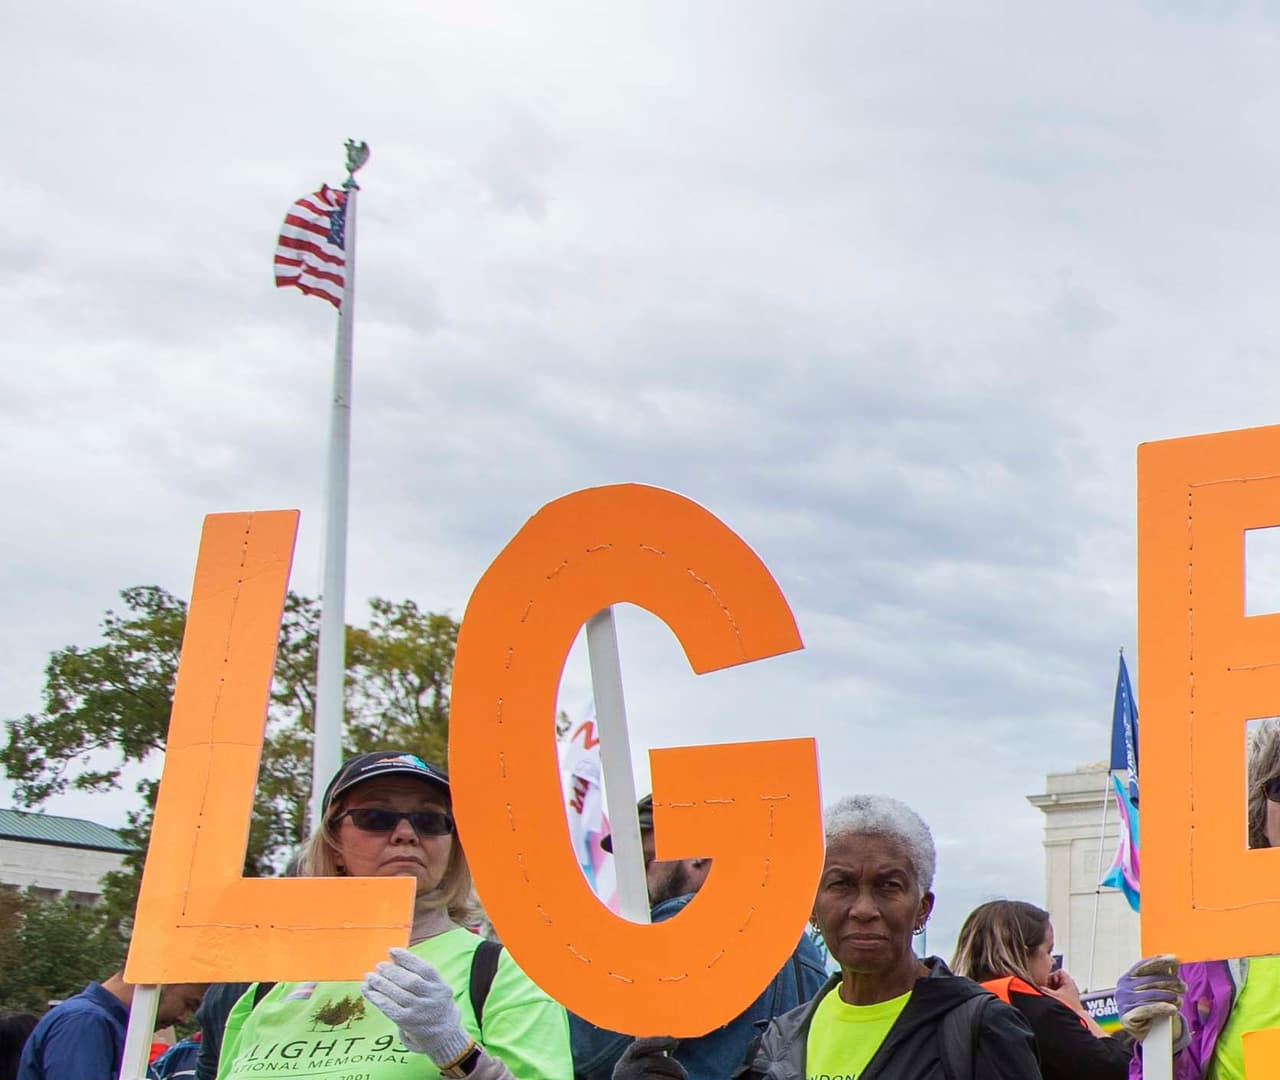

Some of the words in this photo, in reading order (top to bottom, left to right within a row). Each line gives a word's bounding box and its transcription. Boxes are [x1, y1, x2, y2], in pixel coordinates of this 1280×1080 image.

[1086, 999, 1104, 1009] WE
[245, 1037, 366, 1063] LIGHT
[308, 1054, 410, 1070] MEMORIAL
